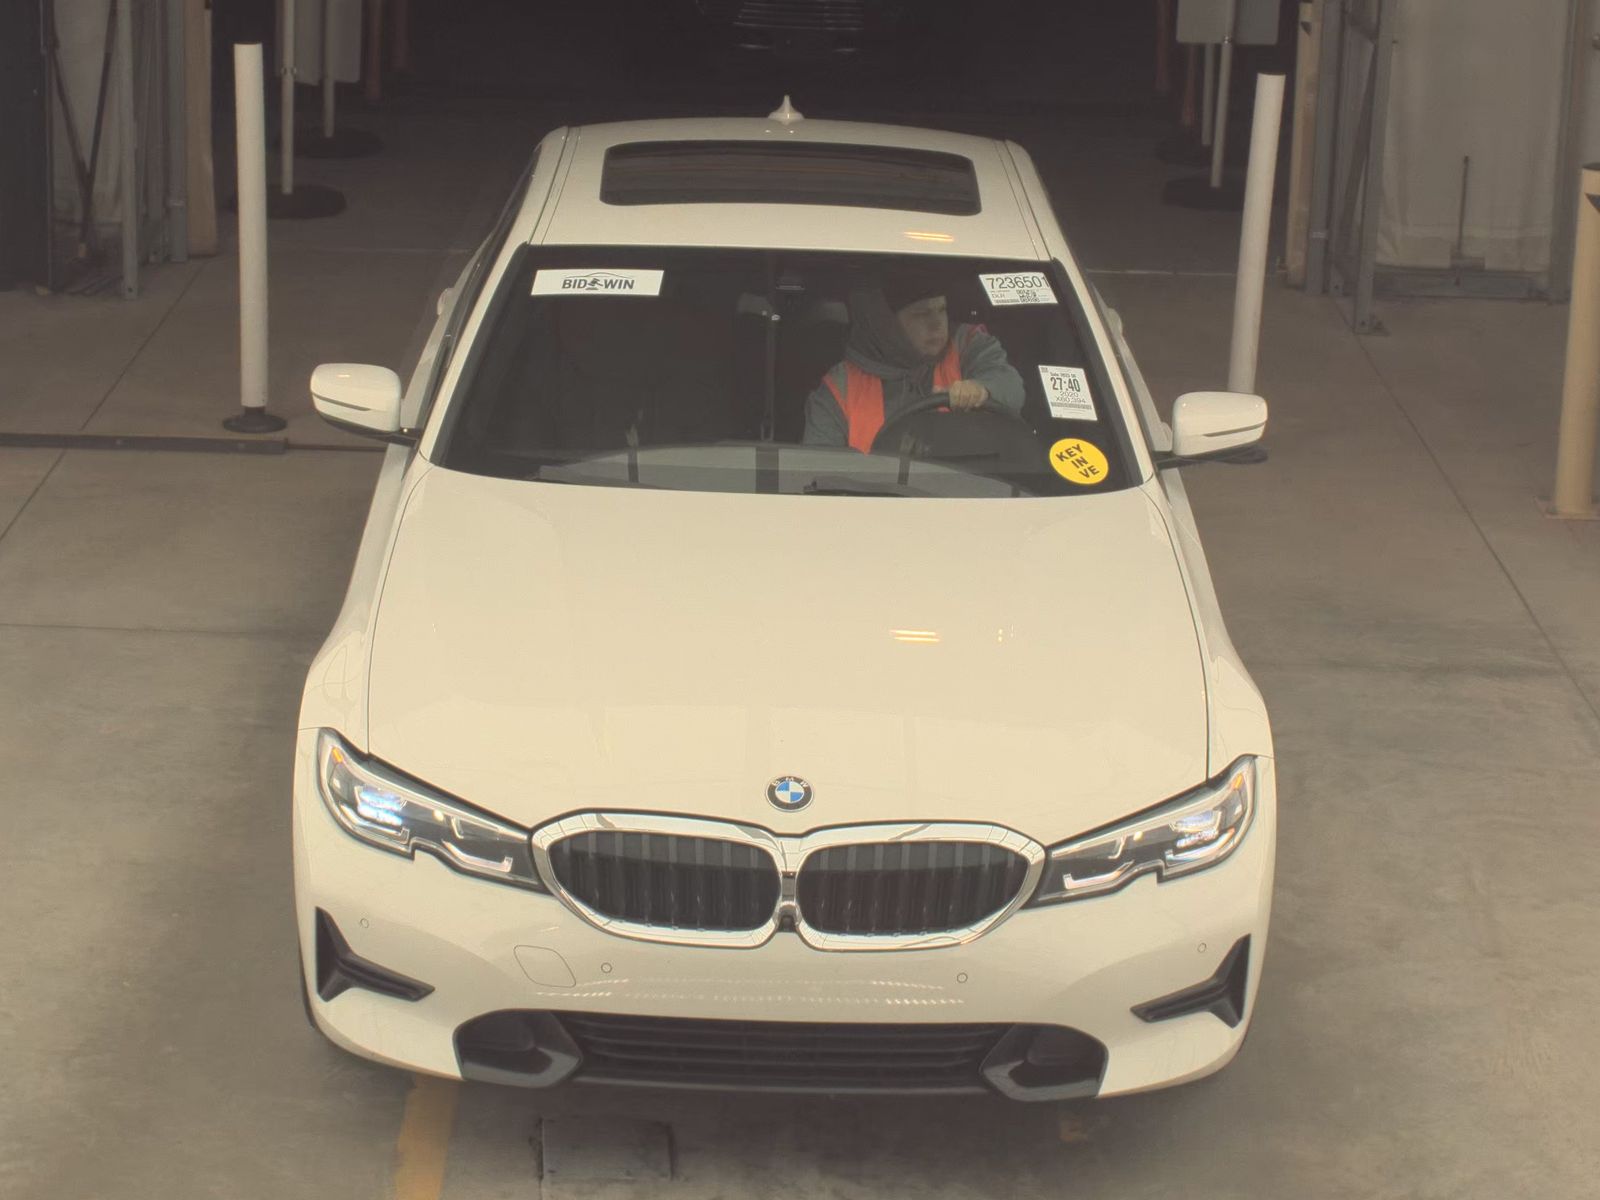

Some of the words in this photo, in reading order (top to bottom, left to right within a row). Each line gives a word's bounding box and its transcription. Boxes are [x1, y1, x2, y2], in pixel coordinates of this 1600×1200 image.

[561, 279, 588, 289] BID
[604, 279, 635, 289] WIN
[985, 275, 1050, 289] 7236501
[1050, 377, 1081, 392] 27:40
[1056, 444, 1083, 462] KEY
[1071, 456, 1089, 469] IN
[1079, 465, 1100, 479] VE
